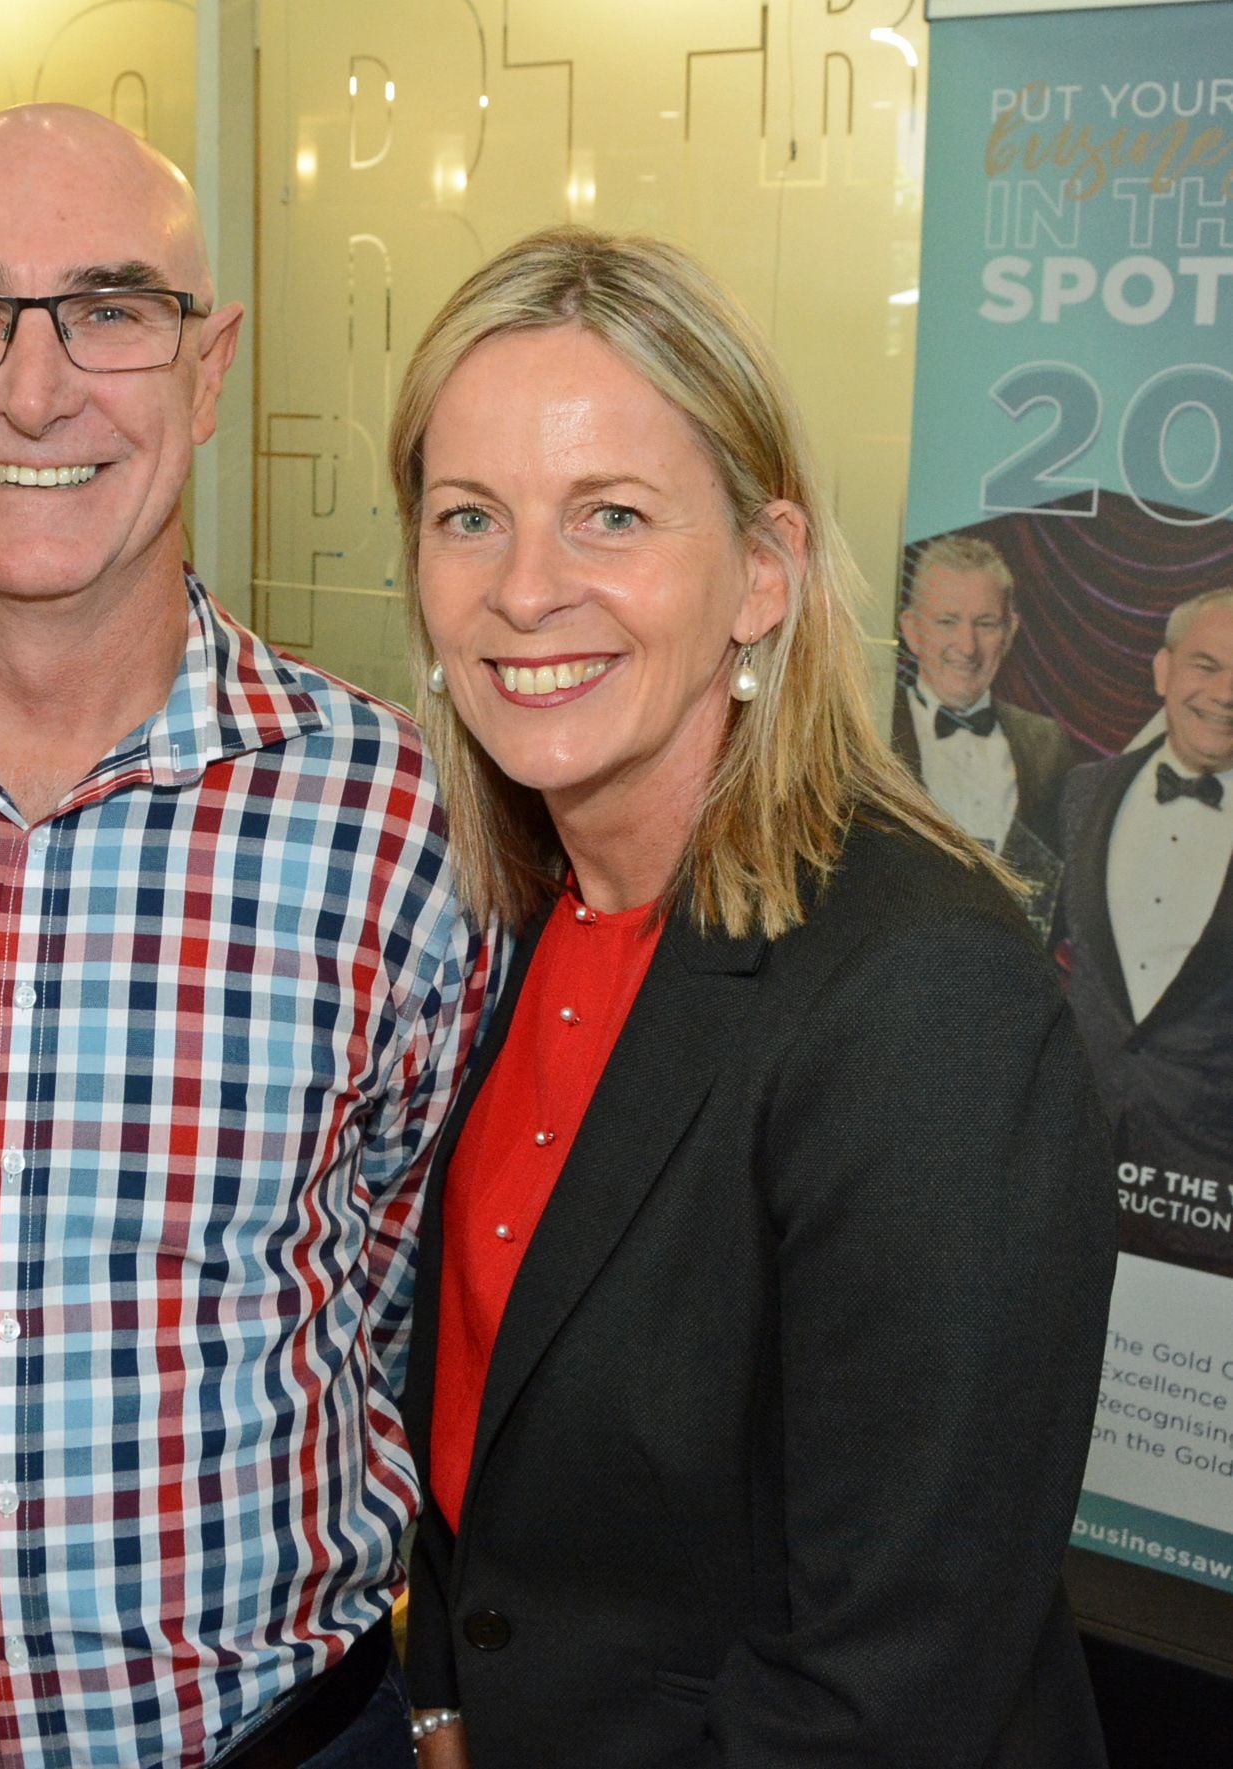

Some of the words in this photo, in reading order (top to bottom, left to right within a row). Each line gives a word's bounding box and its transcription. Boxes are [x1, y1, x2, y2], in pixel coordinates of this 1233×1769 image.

[991, 84, 1083, 123] PUT
[1101, 79, 1233, 119] YOUR
[985, 179, 1082, 249] IN
[978, 255, 1233, 326] SPOT
[980, 359, 1233, 527] 20
[1117, 1162, 1157, 1187] OF
[1164, 1171, 1219, 1202] THE
[1152, 1343, 1212, 1374] Gold
[1127, 1432, 1165, 1458] the
[1175, 1446, 1233, 1477] Gold
